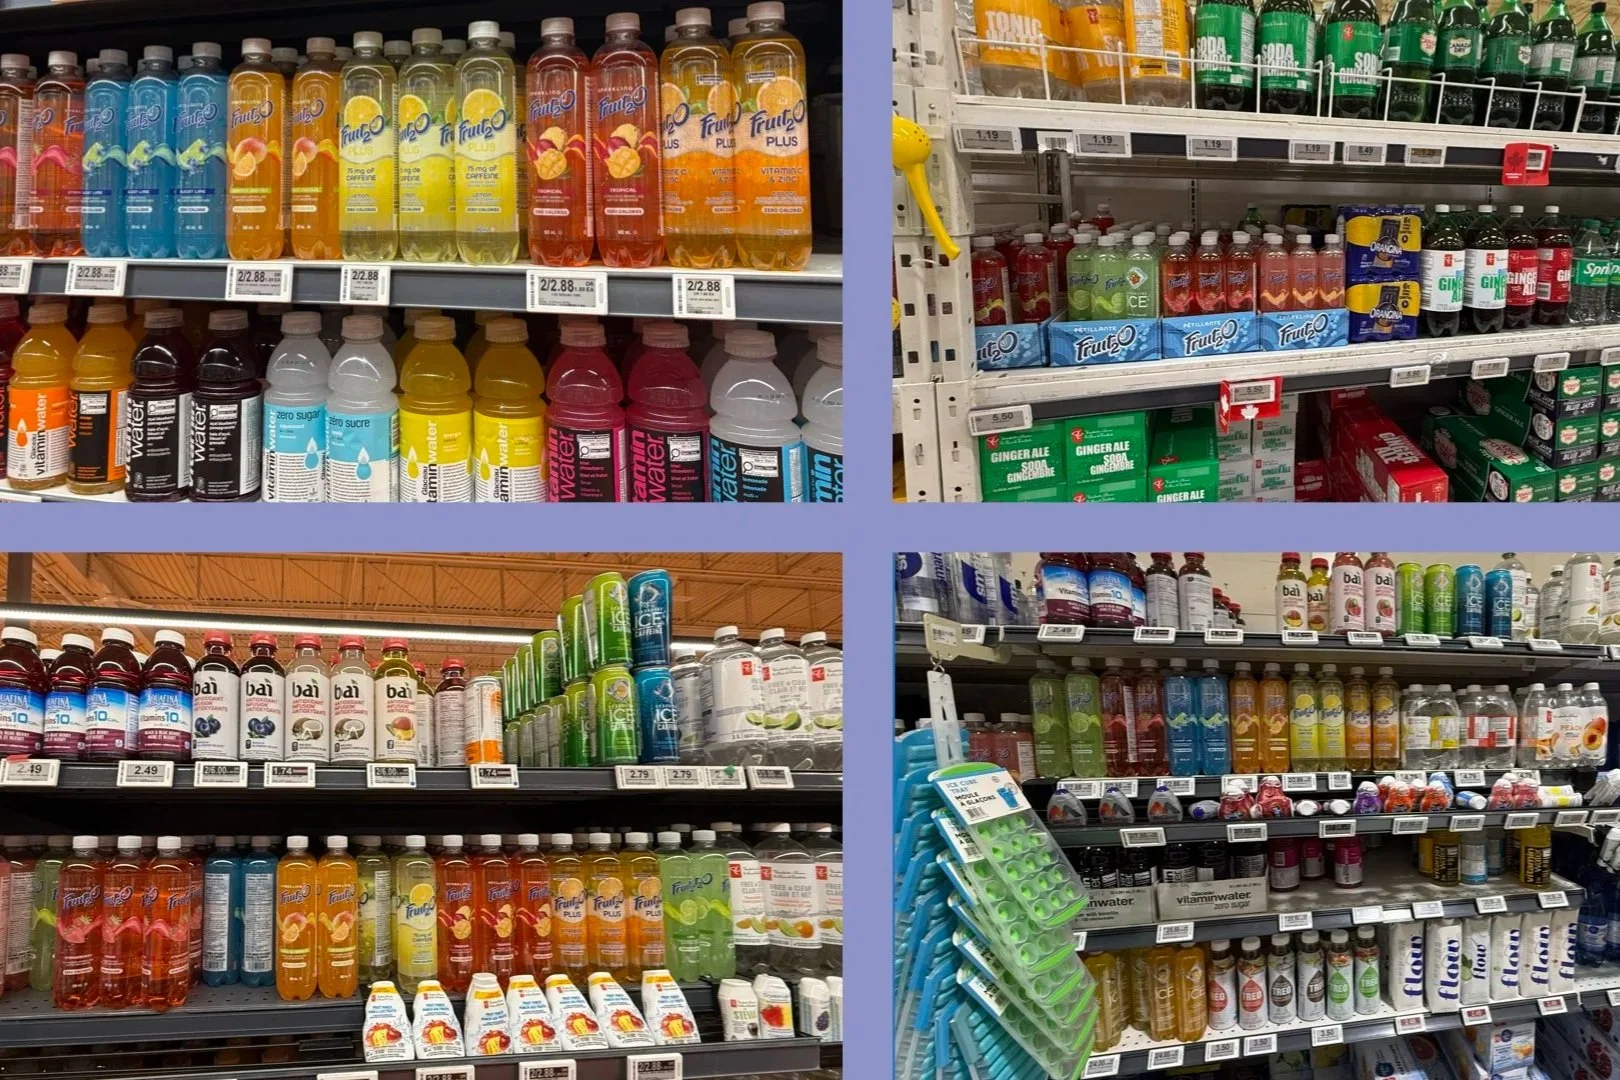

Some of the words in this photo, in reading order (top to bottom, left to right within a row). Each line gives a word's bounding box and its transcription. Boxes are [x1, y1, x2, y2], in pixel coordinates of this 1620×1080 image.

[976, 130, 999, 141] 1.19
[1092, 134, 1113, 145] 1.19
[766, 136, 798, 147] PLUS
[1203, 139, 1222, 149] 1.19
[1304, 143, 1321, 152] 1.19
[237, 270, 265, 283] 2/2.88
[351, 270, 379, 282] 2/2.88
[540, 278, 575, 293] 2/2.88
[687, 280, 721, 293] 2/2.88
[1246, 385, 1265, 395] 5.50
[277, 410, 294, 421] zero
[297, 409, 321, 423] sugar
[992, 411, 1014, 423] 5.50
[345, 417, 371, 429] sucre
[1075, 443, 1112, 457] GINGER
[1111, 441, 1131, 452] ALE
[990, 449, 1028, 464] GINGER
[1030, 446, 1050, 459] ALE
[1103, 452, 1128, 465] SODA
[1020, 459, 1048, 473] SODA
[1090, 460, 1135, 476] GINGEMBRE
[1006, 466, 1056, 484] GINGEMBRE
[1156, 490, 1188, 503] GINGER
[1188, 489, 1206, 500] ALE
[134, 765, 159, 776] 2.49
[272, 766, 293, 776] 1.74
[630, 771, 650, 779] 2.79
[673, 771, 693, 779] 2.79
[955, 792, 980, 801] MOULE
[564, 909, 582, 918] PLUS
[603, 910, 622, 918] PLUS
[1272, 986, 1293, 997] TREO
